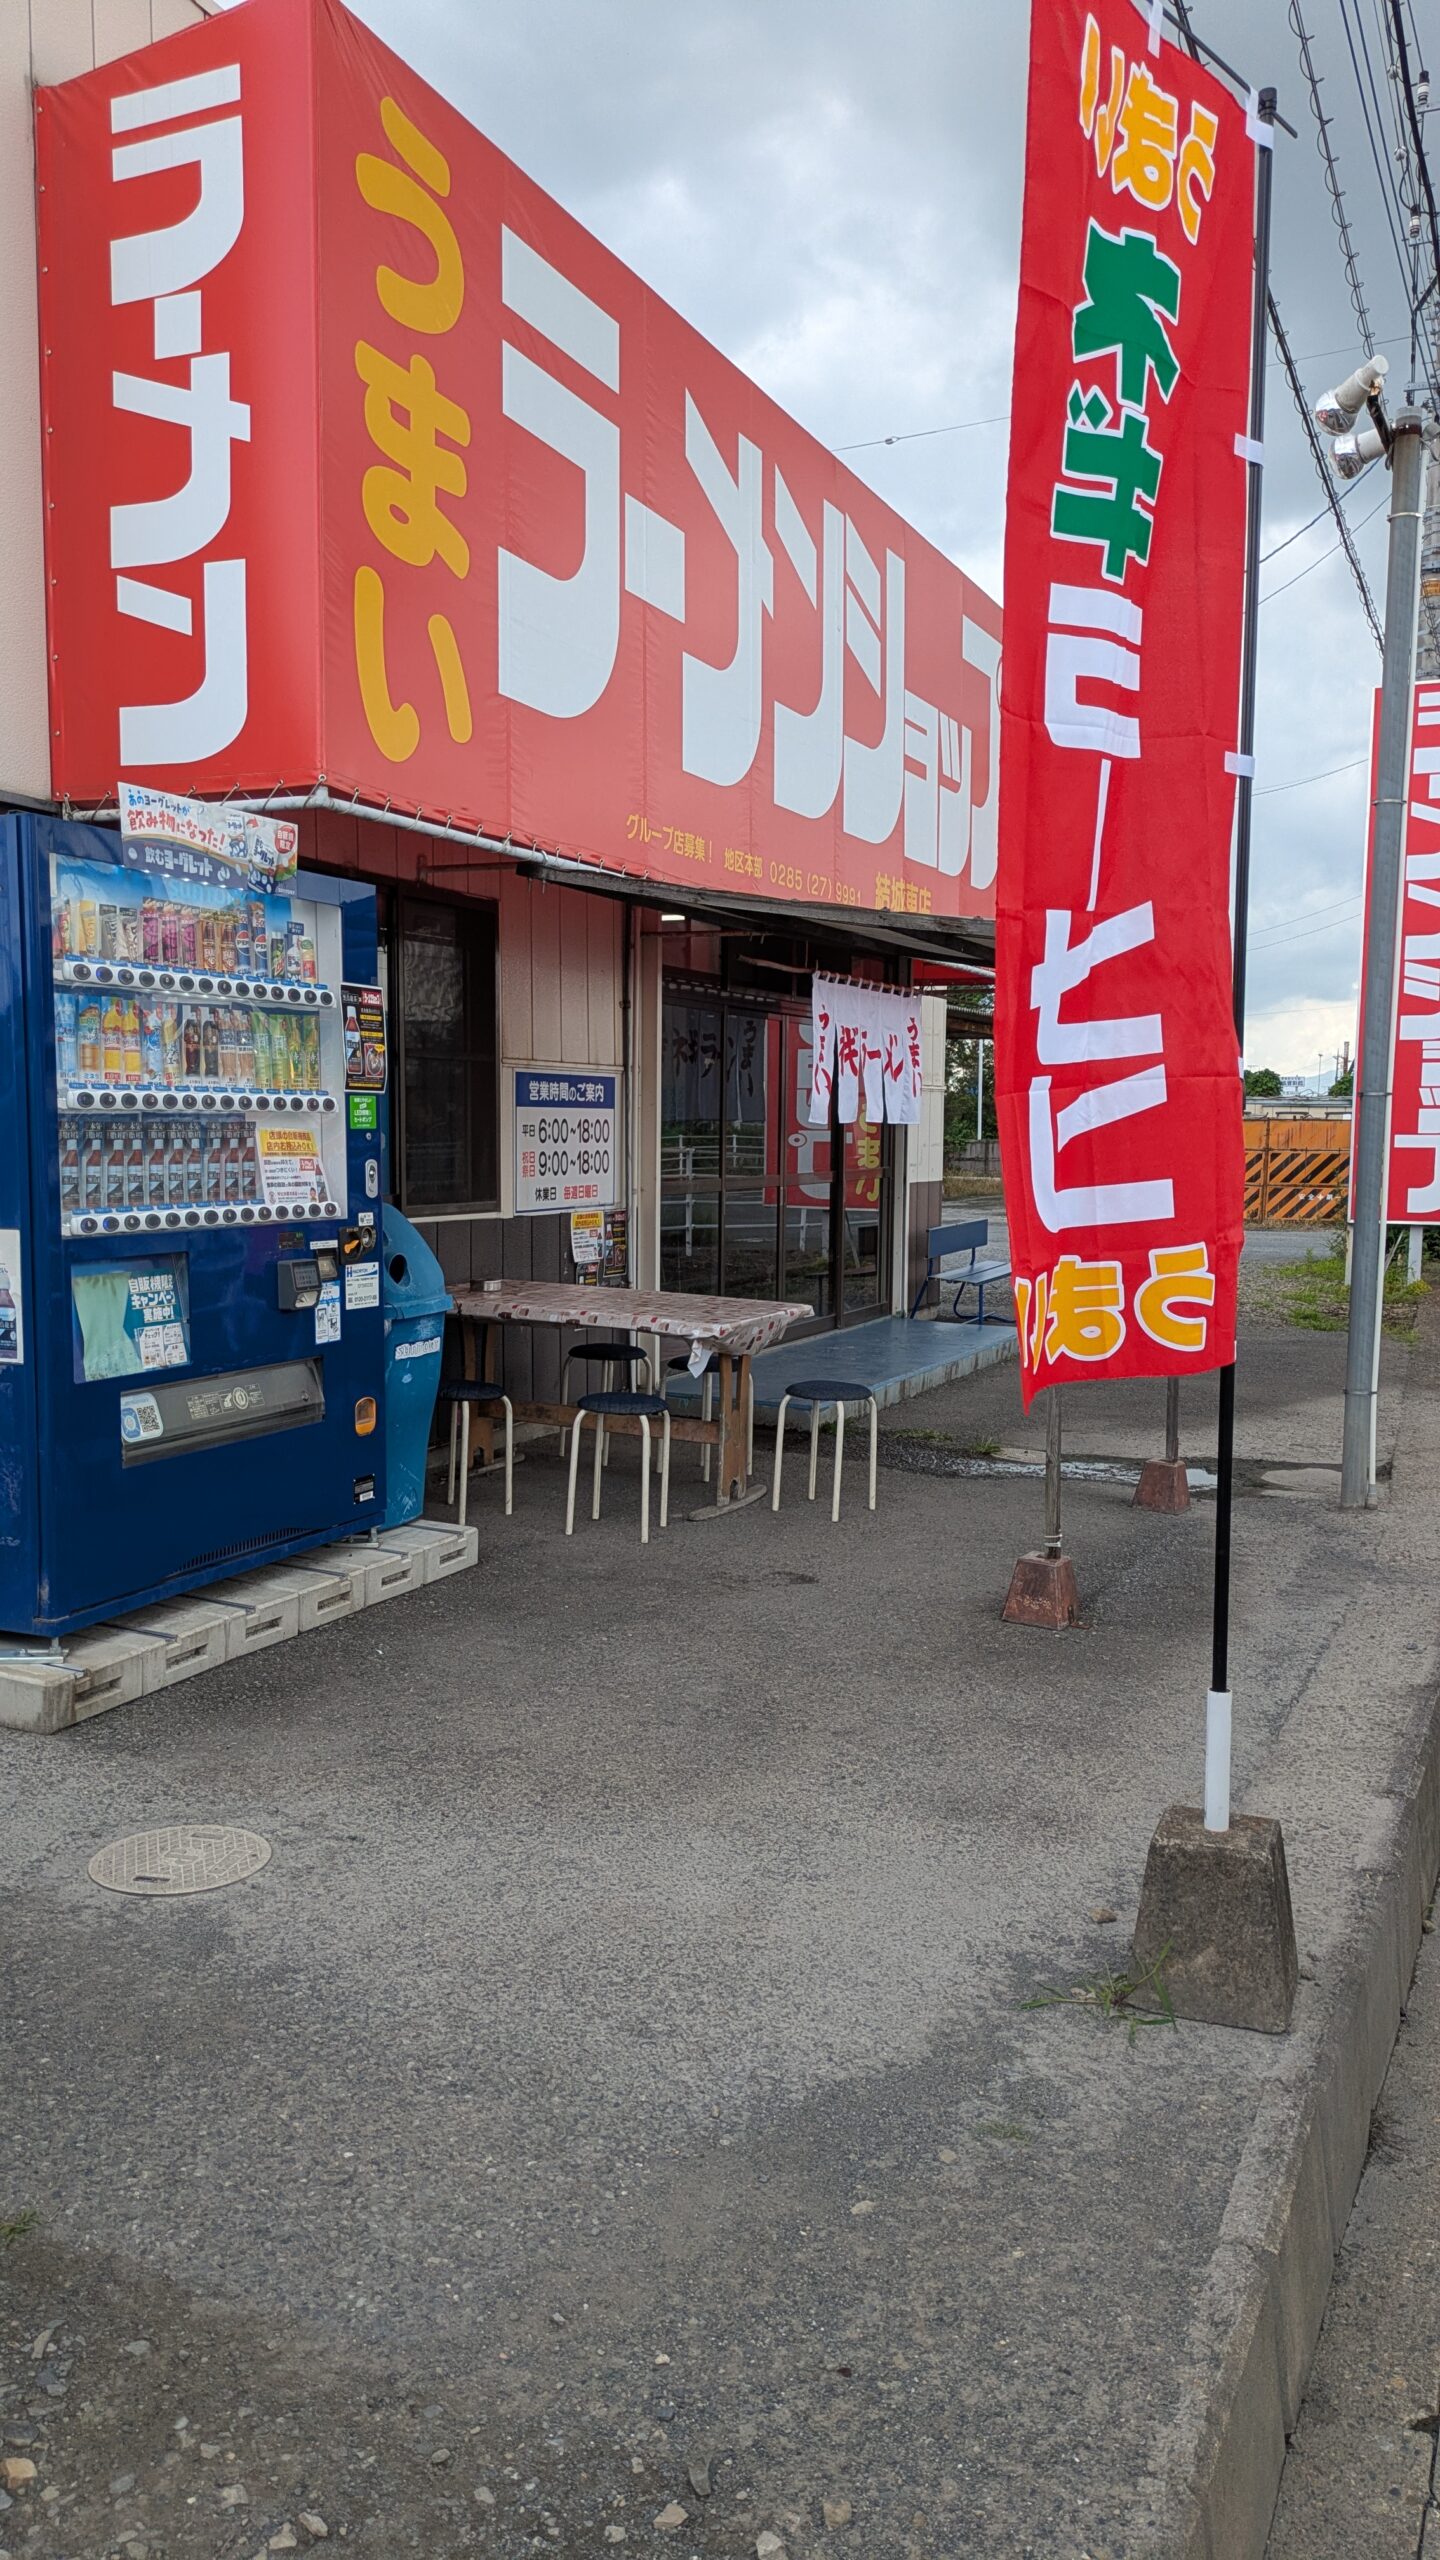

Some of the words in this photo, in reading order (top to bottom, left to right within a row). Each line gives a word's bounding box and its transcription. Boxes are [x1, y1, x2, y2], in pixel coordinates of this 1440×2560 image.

[110, 62, 250, 766] ラーメン
[355, 96, 472, 763] うまい
[127, 788, 191, 815] あのヨーグレットが
[145, 846, 213, 877] 飲むヨーグレット
[724, 847, 762, 879] 地区本部
[769, 861, 803, 891] 0285
[529, 1080, 604, 1103] 営業時間のご案内
[522, 1124, 535, 1137] 平日
[522, 1151, 535, 1164] 祝日
[522, 1165, 535, 1178] 祭日
[535, 1186, 557, 1202] 休業日
[563, 1184, 598, 1200] 毎週日曜日
